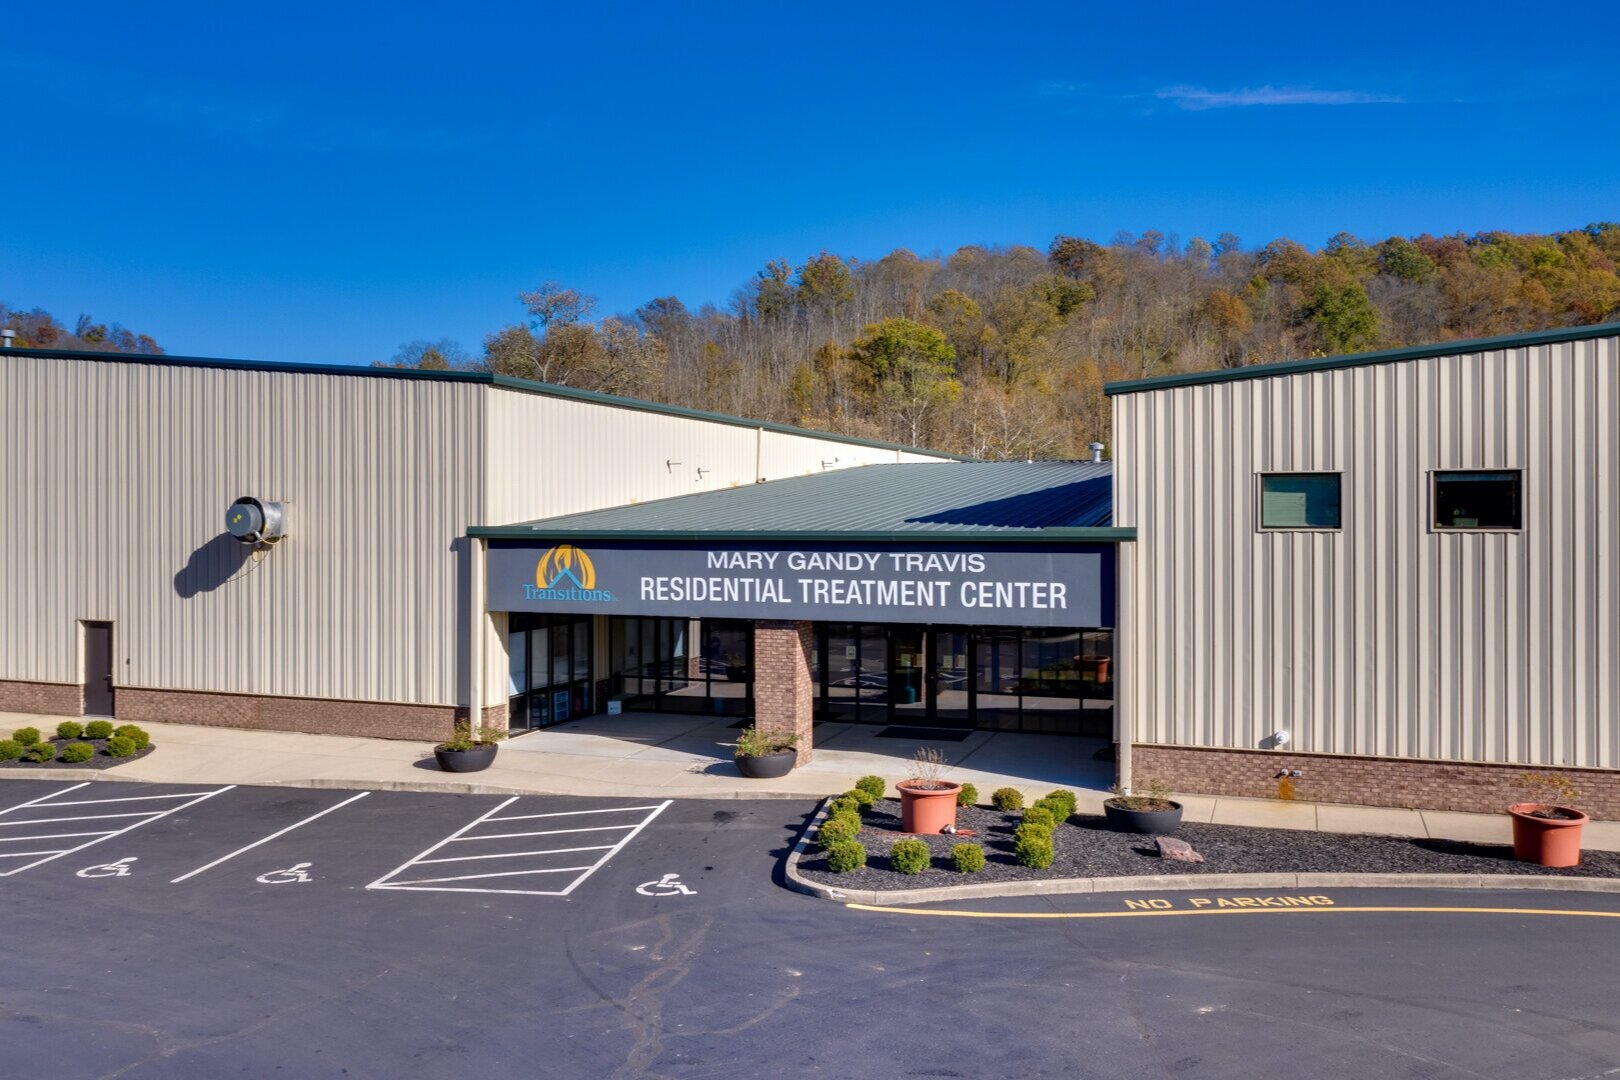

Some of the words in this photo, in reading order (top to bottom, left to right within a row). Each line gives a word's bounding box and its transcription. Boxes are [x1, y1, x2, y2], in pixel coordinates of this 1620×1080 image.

[707, 551, 779, 570] MARY
[787, 552, 880, 571] GANDY
[889, 553, 986, 573] TRAVIS
[522, 584, 611, 601] Transitions
[641, 577, 791, 603] RESIDENTIAL
[798, 579, 951, 606] TREATMENT
[960, 582, 1067, 609] CENTER
[1124, 899, 1173, 910] NO
[1189, 895, 1335, 908] PARKING
